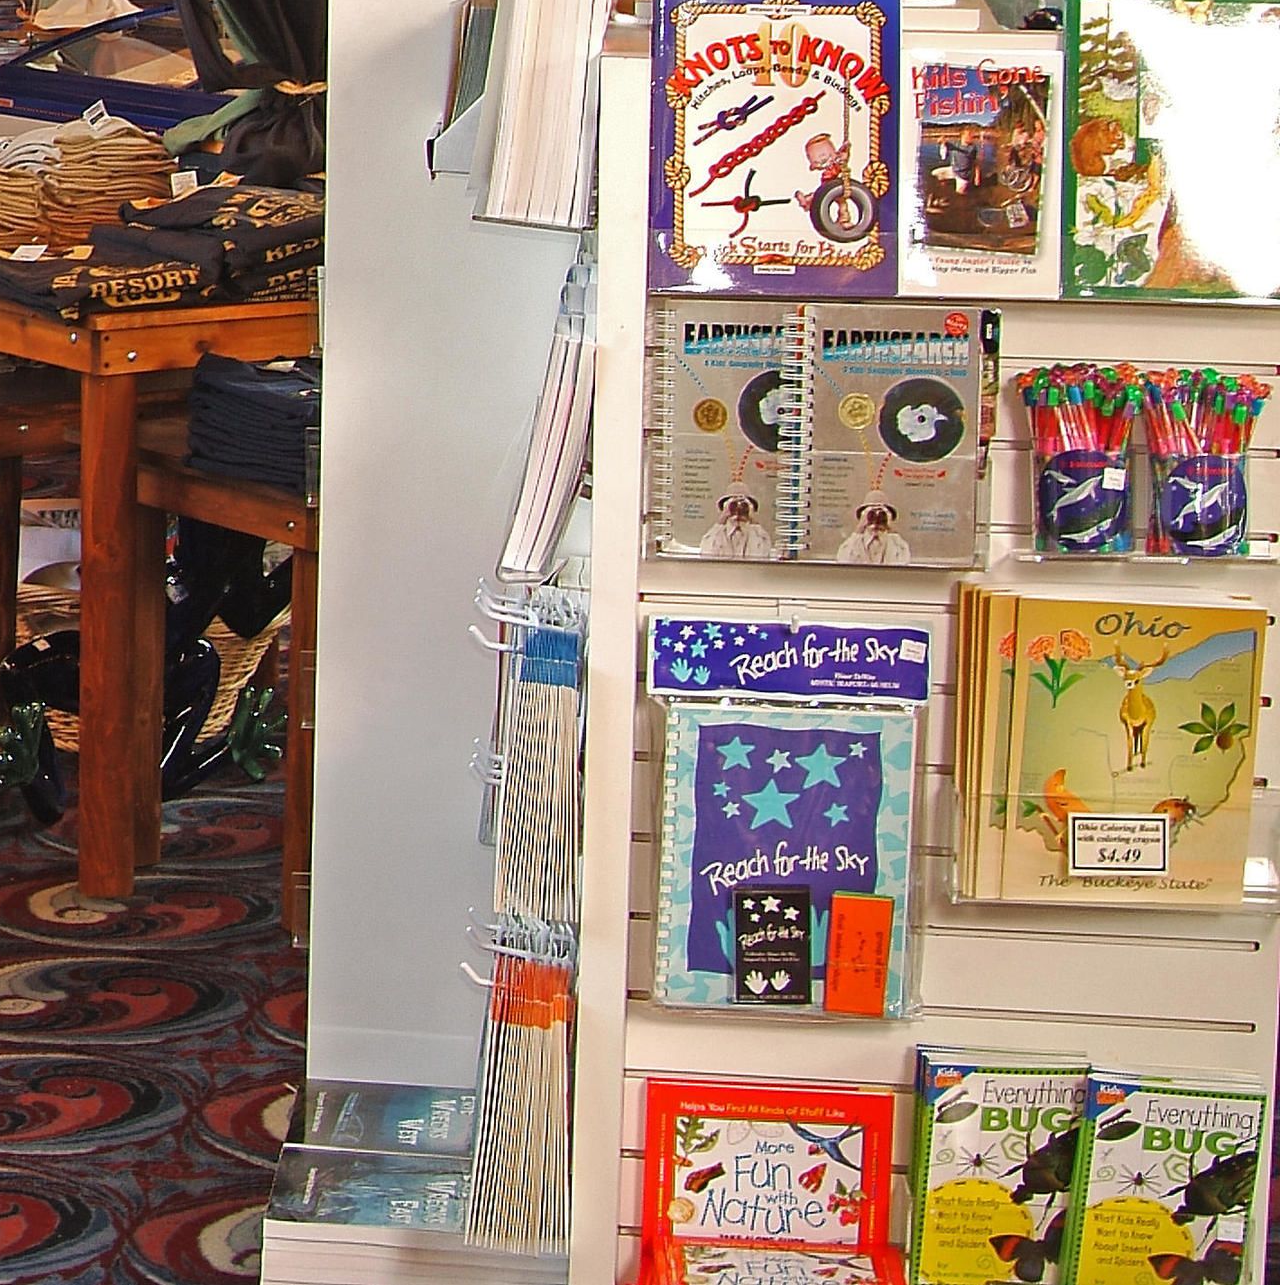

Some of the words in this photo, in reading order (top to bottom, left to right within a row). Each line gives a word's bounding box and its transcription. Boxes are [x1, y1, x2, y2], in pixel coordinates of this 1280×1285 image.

[666, 32, 764, 95] KNOTS
[769, 39, 791, 56] TO
[798, 34, 893, 107] KNOW
[912, 62, 968, 90] Kids
[977, 58, 1046, 86] Gone
[690, 76, 731, 110] Hitches,
[731, 65, 771, 80] Loops,
[773, 63, 809, 76] Bends
[811, 70, 820, 80] &
[914, 85, 1010, 120] Fishin'
[740, 236, 791, 255] Starts
[796, 240, 816, 255] for
[90, 268, 200, 299] RESORT
[822, 328, 971, 365] EARTHSEARCH
[1094, 610, 1191, 638] Ohio
[729, 639, 798, 686] Reach
[802, 633, 830, 668] for
[828, 638, 858, 664] the
[865, 637, 900, 666] Sky
[1077, 823, 1098, 832] Ohio
[1100, 823, 1137, 833] Coloring
[1077, 834, 1094, 842] with
[1097, 835, 1130, 844] coloring
[1132, 836, 1161, 845] crayon
[700, 848, 770, 896] Reach
[774, 841, 801, 876] for
[798, 845, 829, 872] the
[835, 845, 870, 876] Sky
[1097, 847, 1142, 863] $4.49
[1039, 875, 1070, 887] The
[738, 928, 765, 950] Reach
[766, 922, 777, 941] for
[778, 925, 790, 939] the
[790, 924, 805, 940] Sky
[680, 1101, 706, 1112] Helps
[708, 1102, 725, 1112] You
[726, 1103, 745, 1113] Find
[760, 1105, 785, 1114] Kinds
[786, 1106, 798, 1115] of
[800, 1107, 824, 1116] Stuff
[826, 1109, 845, 1117] Like
[982, 1079, 1086, 1112] Everything
[980, 1106, 1073, 1132] BUG
[1145, 1100, 1254, 1138] Everything
[755, 1140, 795, 1155] More
[1143, 1126, 1240, 1157] BUG
[734, 1154, 792, 1192] Fun
[701, 1188, 826, 1235] Nature
[764, 1189, 798, 1206] with
[1093, 1214, 1115, 1224] What
[1117, 1215, 1135, 1225] Kids
[1136, 1216, 1160, 1229] Really
[1096, 1227, 1117, 1237] Want
[1119, 1229, 1128, 1238] to
[1131, 1230, 1153, 1241] Know
[1093, 1241, 1119, 1251] About
[1121, 1243, 1152, 1253] Insects
[1096, 1256, 1112, 1265] and
[1114, 1257, 1145, 1267] Spiders
